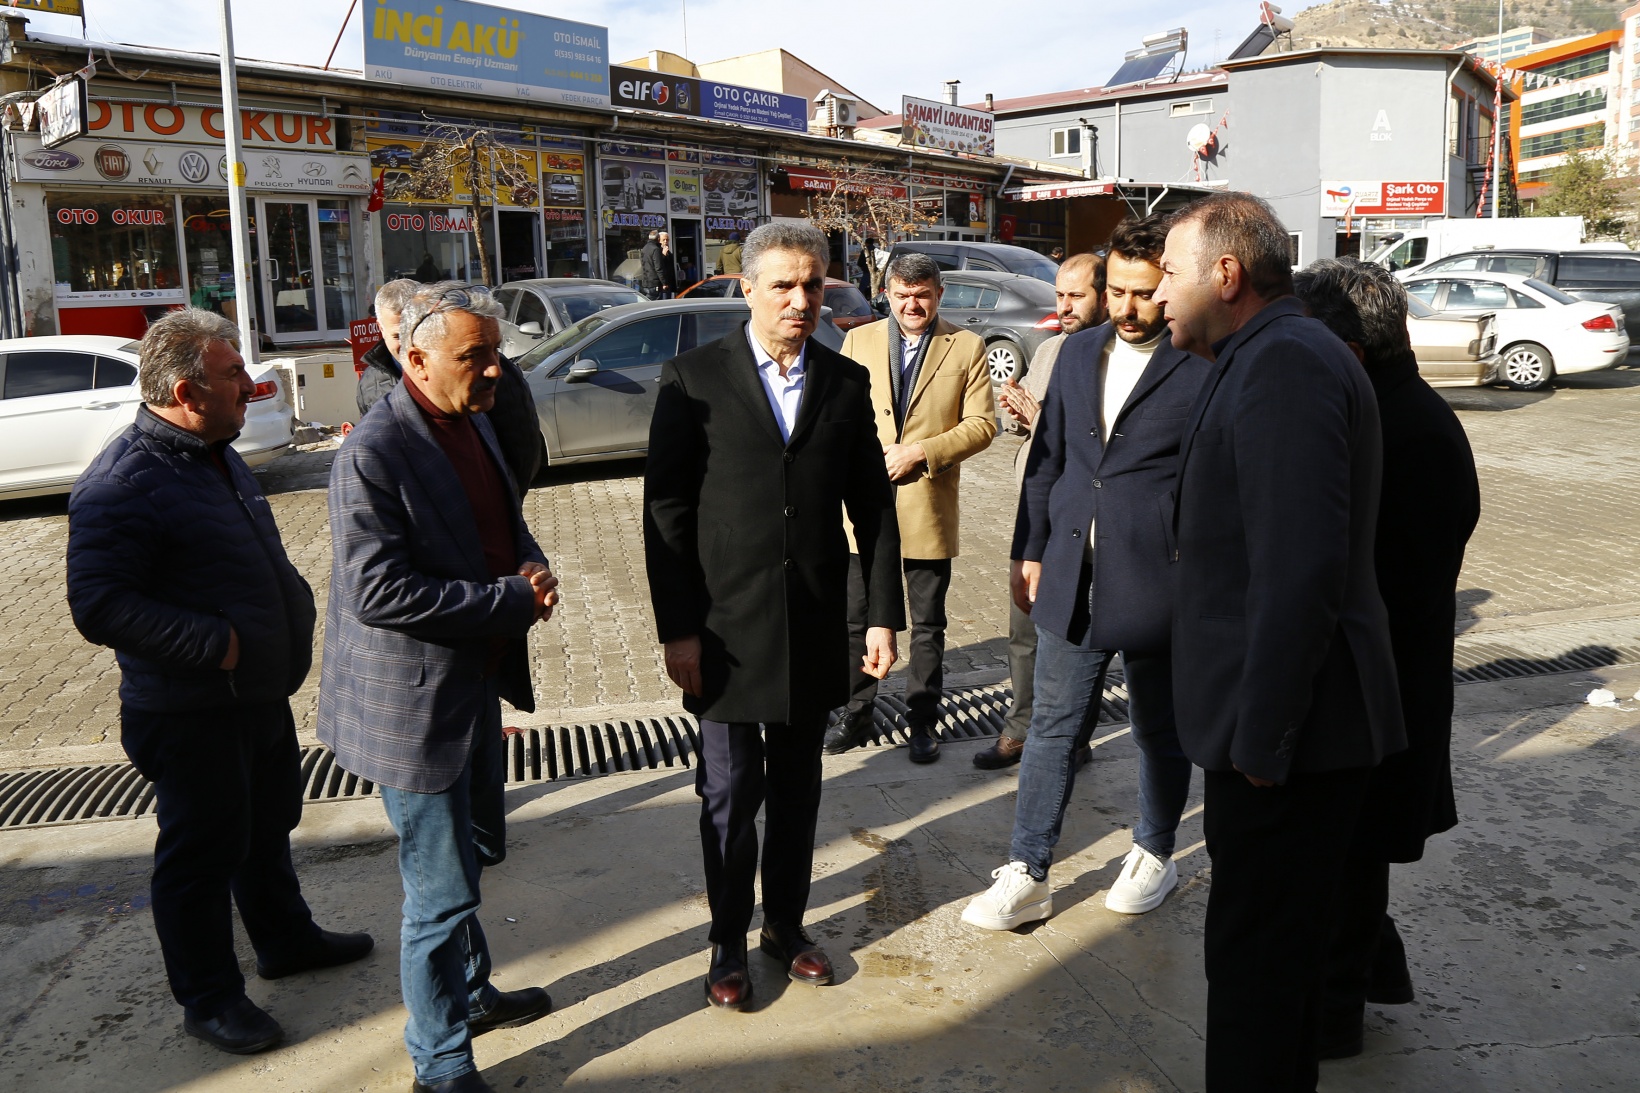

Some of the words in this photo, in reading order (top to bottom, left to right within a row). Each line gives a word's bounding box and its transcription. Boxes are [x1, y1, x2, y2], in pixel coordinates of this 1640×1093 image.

[373, 0, 443, 48] İNCİ
[447, 16, 519, 59] AKÜ
[554, 31, 571, 44] OTO
[572, 32, 601, 49] İSMAİL
[404, 46, 451, 62] Dünyanın
[454, 53, 482, 69] Enerji
[484, 58, 518, 72] Uzmanı
[375, 69, 393, 79] AKÜ
[430, 76, 446, 86] OTO
[447, 77, 483, 91] ELEKTRİK
[516, 86, 530, 97] YAĞ
[561, 93, 581, 103] YEDEK
[582, 96, 603, 106] PARÇA
[618, 80, 650, 101] elf
[713, 85, 740, 102] OTO
[743, 89, 780, 109] ÇAKIR
[905, 102, 943, 124] SANAYİ
[943, 110, 993, 134] LOKANTASI
[1372, 109, 1392, 131] A
[1370, 133, 1392, 142] BLOK
[33, 153, 70, 169] Ford
[103, 154, 124, 169] FIAT
[297, 178, 333, 186] HYUNDAI
[1386, 183, 1414, 196] Şark
[1416, 184, 1439, 194] Oto
[1036, 190, 1052, 198] CAFE
[57, 208, 99, 225] OTO
[112, 208, 165, 226] OKUR
[387, 214, 425, 232] OTO
[429, 211, 475, 233] İSMAİ
[545, 211, 562, 220] OTO
[606, 213, 641, 229] ÇAKIR
[642, 214, 665, 228] OTO
[705, 217, 736, 232] ÇAKIR
[353, 324, 367, 337] OTO
[368, 322, 381, 335] OKU
